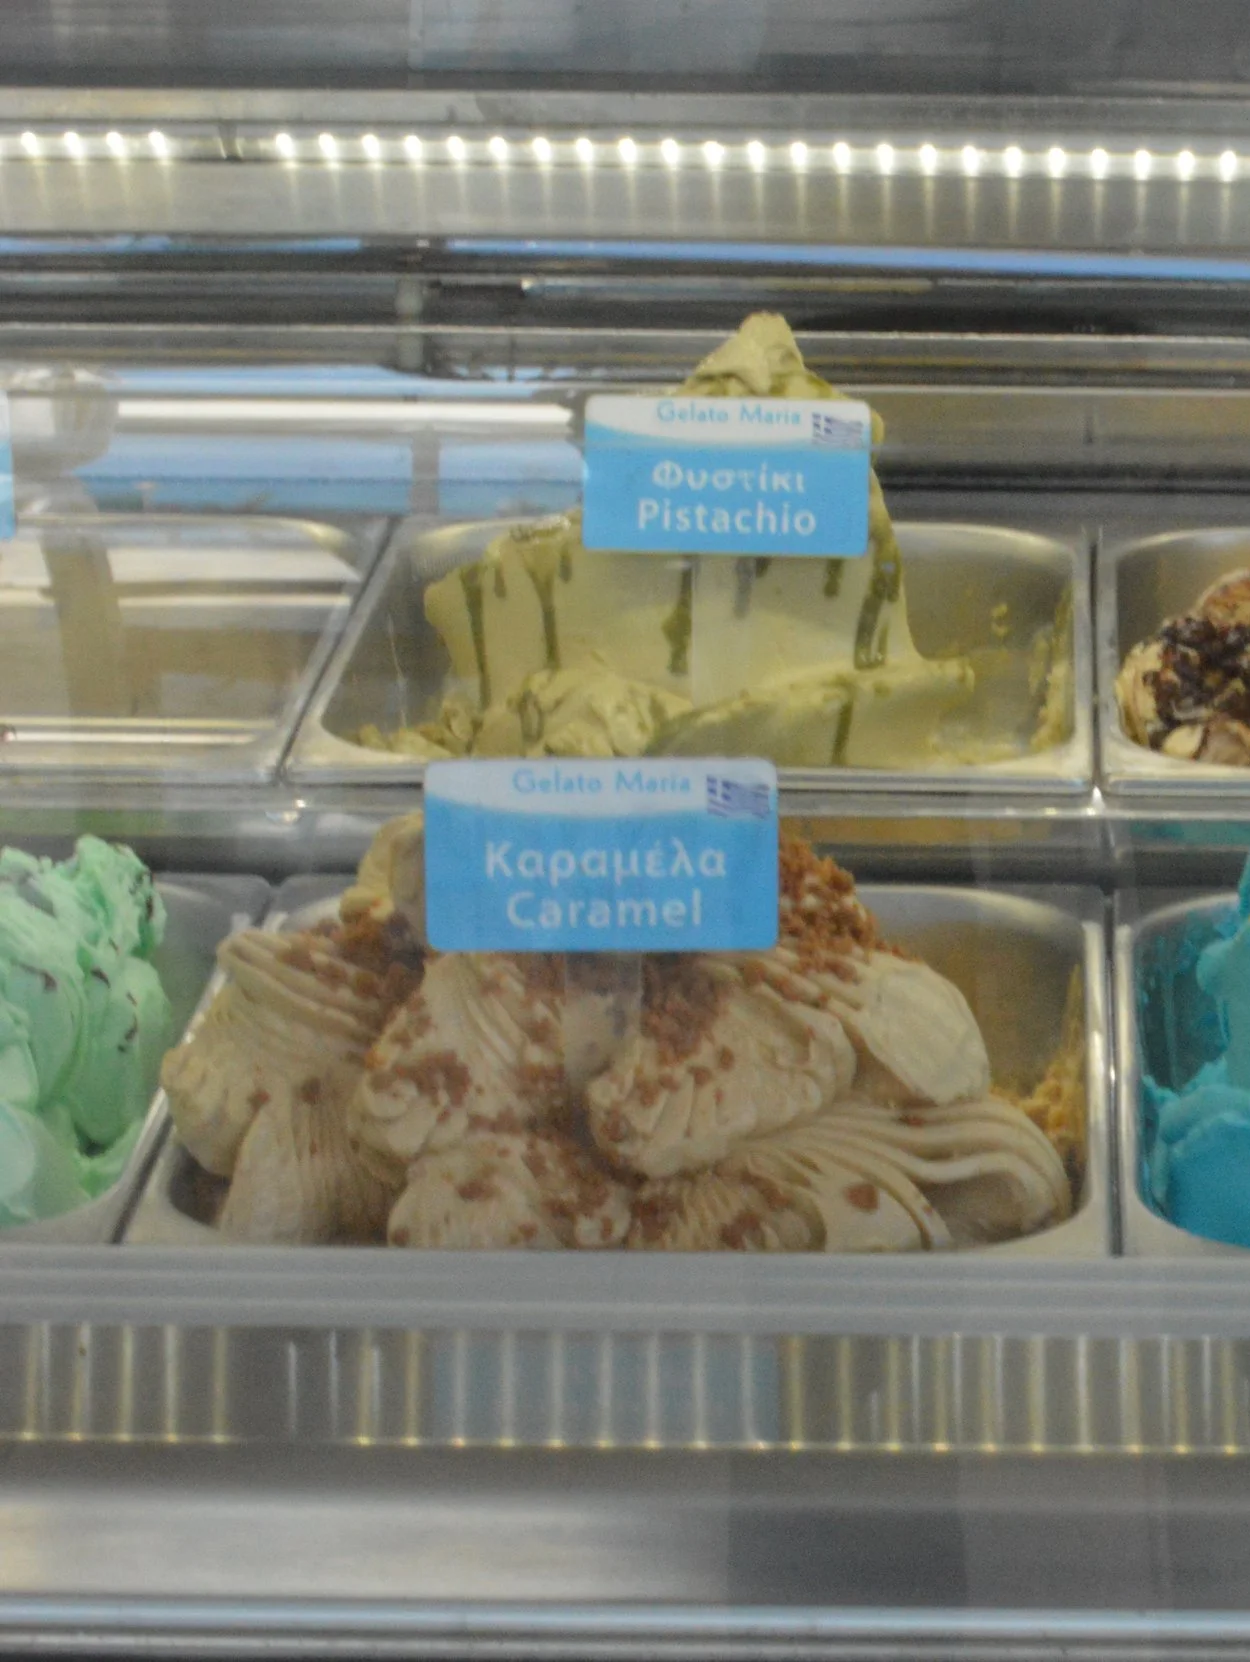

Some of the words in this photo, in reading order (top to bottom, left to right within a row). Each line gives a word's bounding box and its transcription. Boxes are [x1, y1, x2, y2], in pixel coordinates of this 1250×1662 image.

[656, 402, 730, 423] Gelato
[739, 404, 802, 425] Maria
[651, 460, 806, 494] Φυστίκι
[636, 499, 818, 535] Pistachio
[511, 769, 602, 794] Gelato
[615, 770, 692, 794] Maria
[485, 839, 727, 886] Καραμέλα
[506, 889, 702, 930] Caramel
